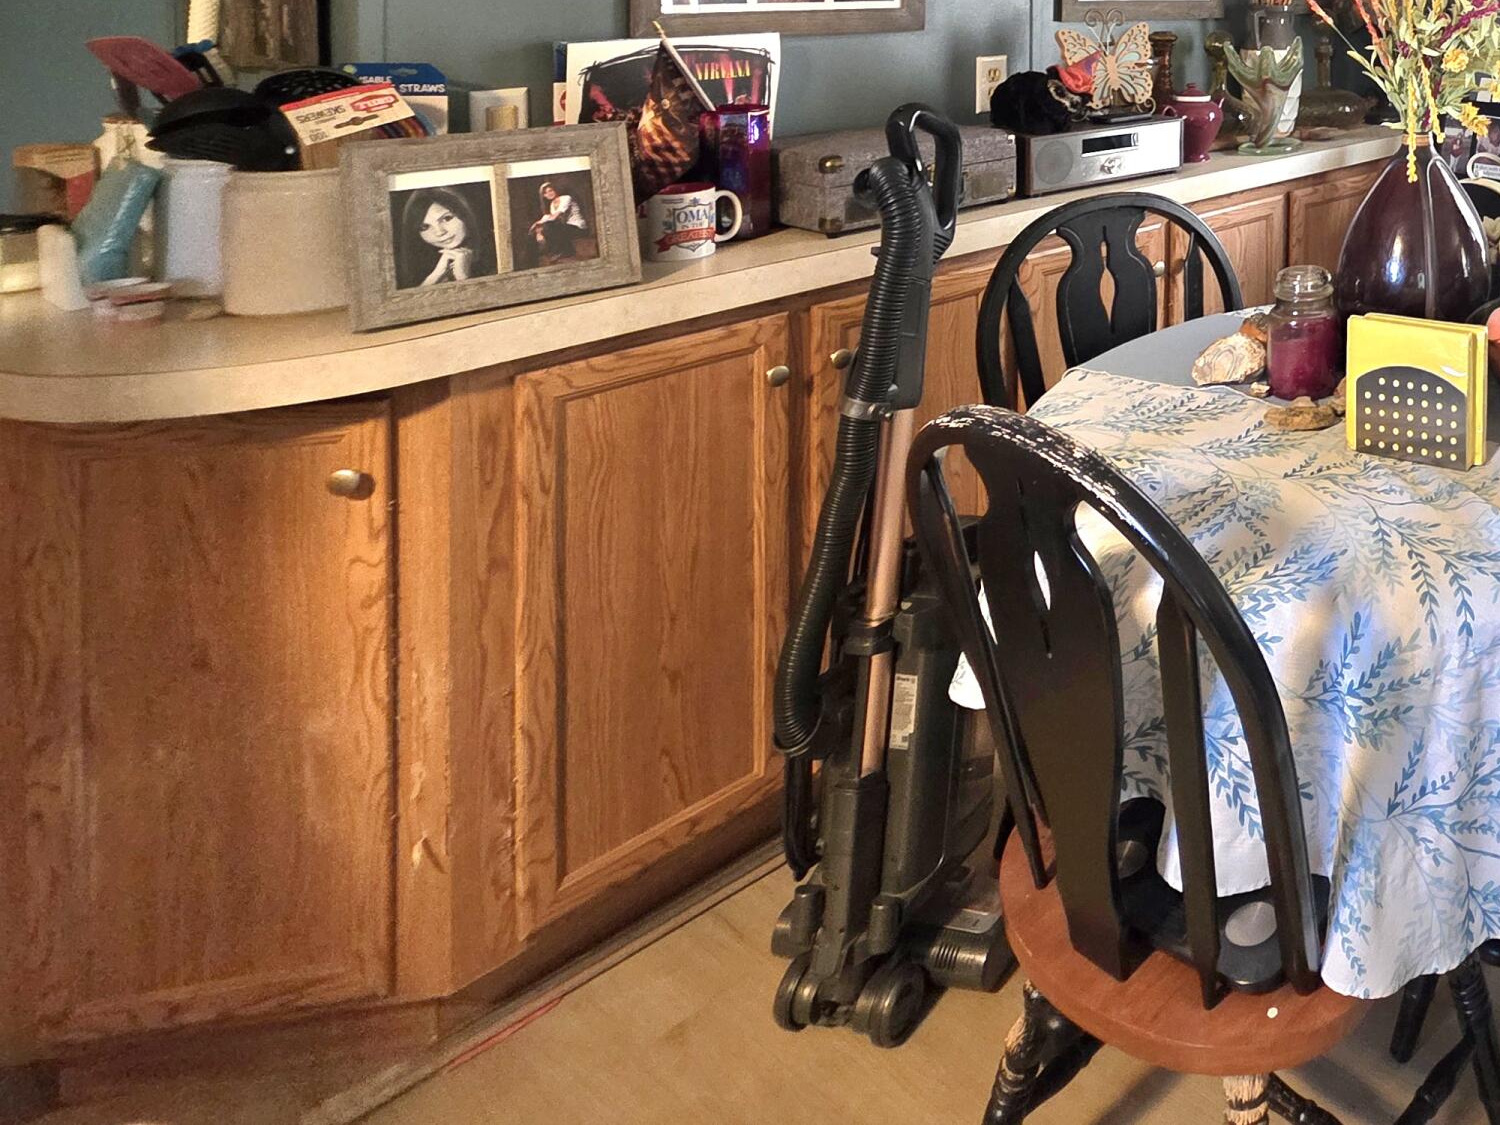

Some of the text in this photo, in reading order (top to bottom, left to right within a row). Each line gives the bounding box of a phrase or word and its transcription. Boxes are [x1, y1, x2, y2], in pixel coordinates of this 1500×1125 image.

[695, 59, 751, 81] NIRVANA
[359, 76, 392, 84] SABLE
[398, 83, 446, 93] STRAWS
[295, 104, 347, 124] SKEWERS
